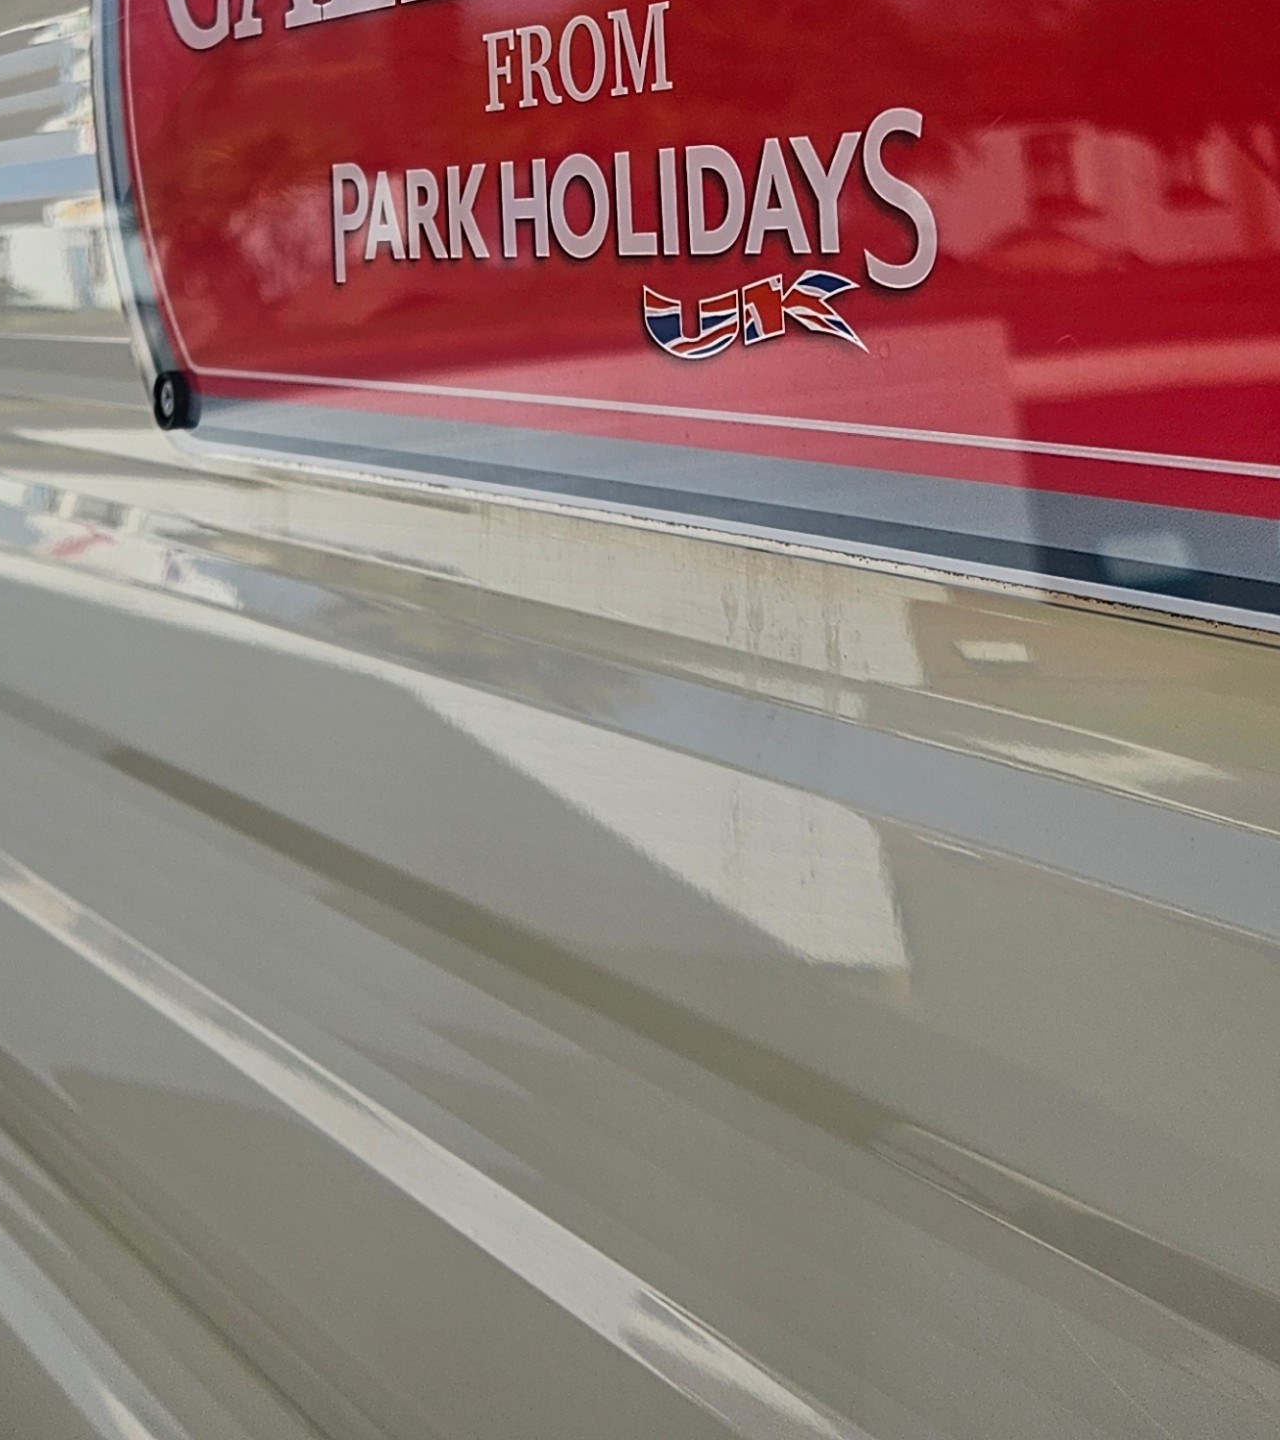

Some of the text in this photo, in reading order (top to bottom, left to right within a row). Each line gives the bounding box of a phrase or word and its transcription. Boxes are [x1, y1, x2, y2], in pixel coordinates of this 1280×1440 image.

[482, 0, 673, 112] FROM
[331, 107, 938, 289] PARK HOLIDAYS
[642, 269, 871, 360] UK
